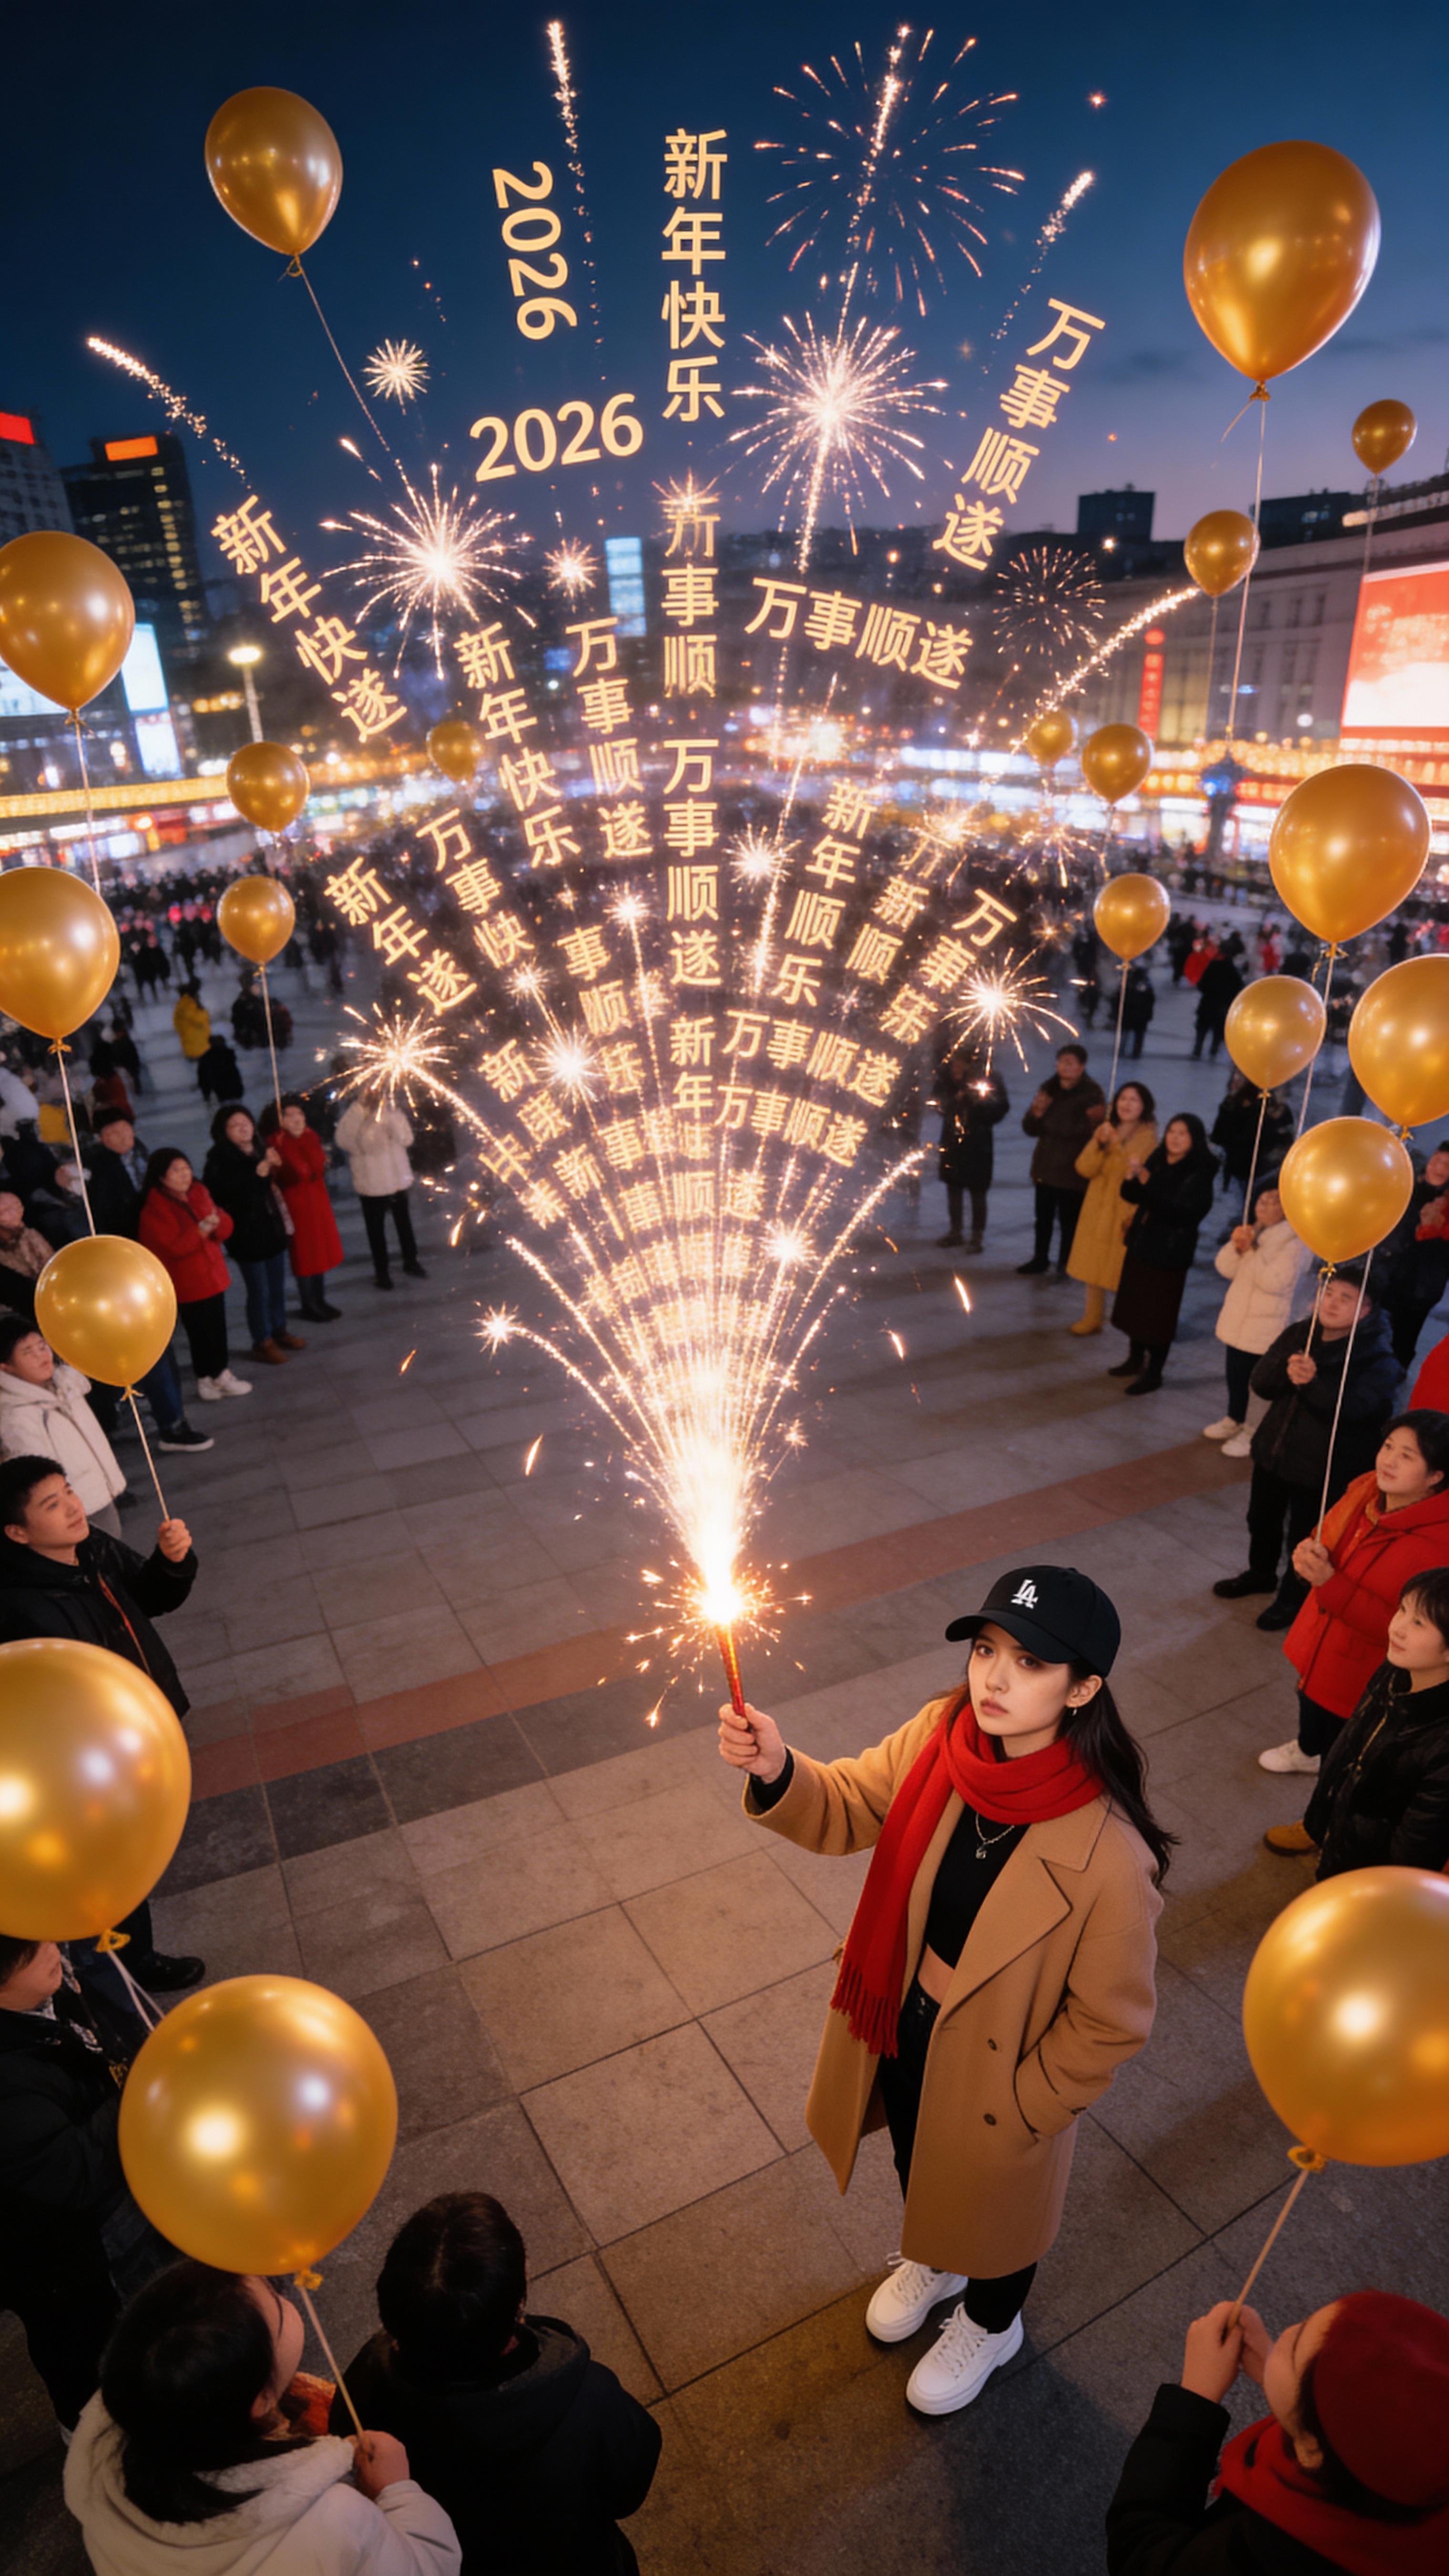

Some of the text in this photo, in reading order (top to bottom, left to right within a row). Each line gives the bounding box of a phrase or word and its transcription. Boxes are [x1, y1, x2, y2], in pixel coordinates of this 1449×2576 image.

[492, 161, 577, 340] 2026
[662, 128, 728, 422] 新年快乐
[469, 393, 643, 482] 2026
[933, 297, 1105, 570] 万事顺遂
[565, 617, 653, 859] 万事顺遂
[745, 577, 973, 689] 万事顺遂
[453, 622, 581, 868] 新年快乐
[663, 739, 722, 986] 万事顺遂
[722, 1010, 902, 1107] 万事顺遂
[1010, 1579, 1039, 1609] LA
